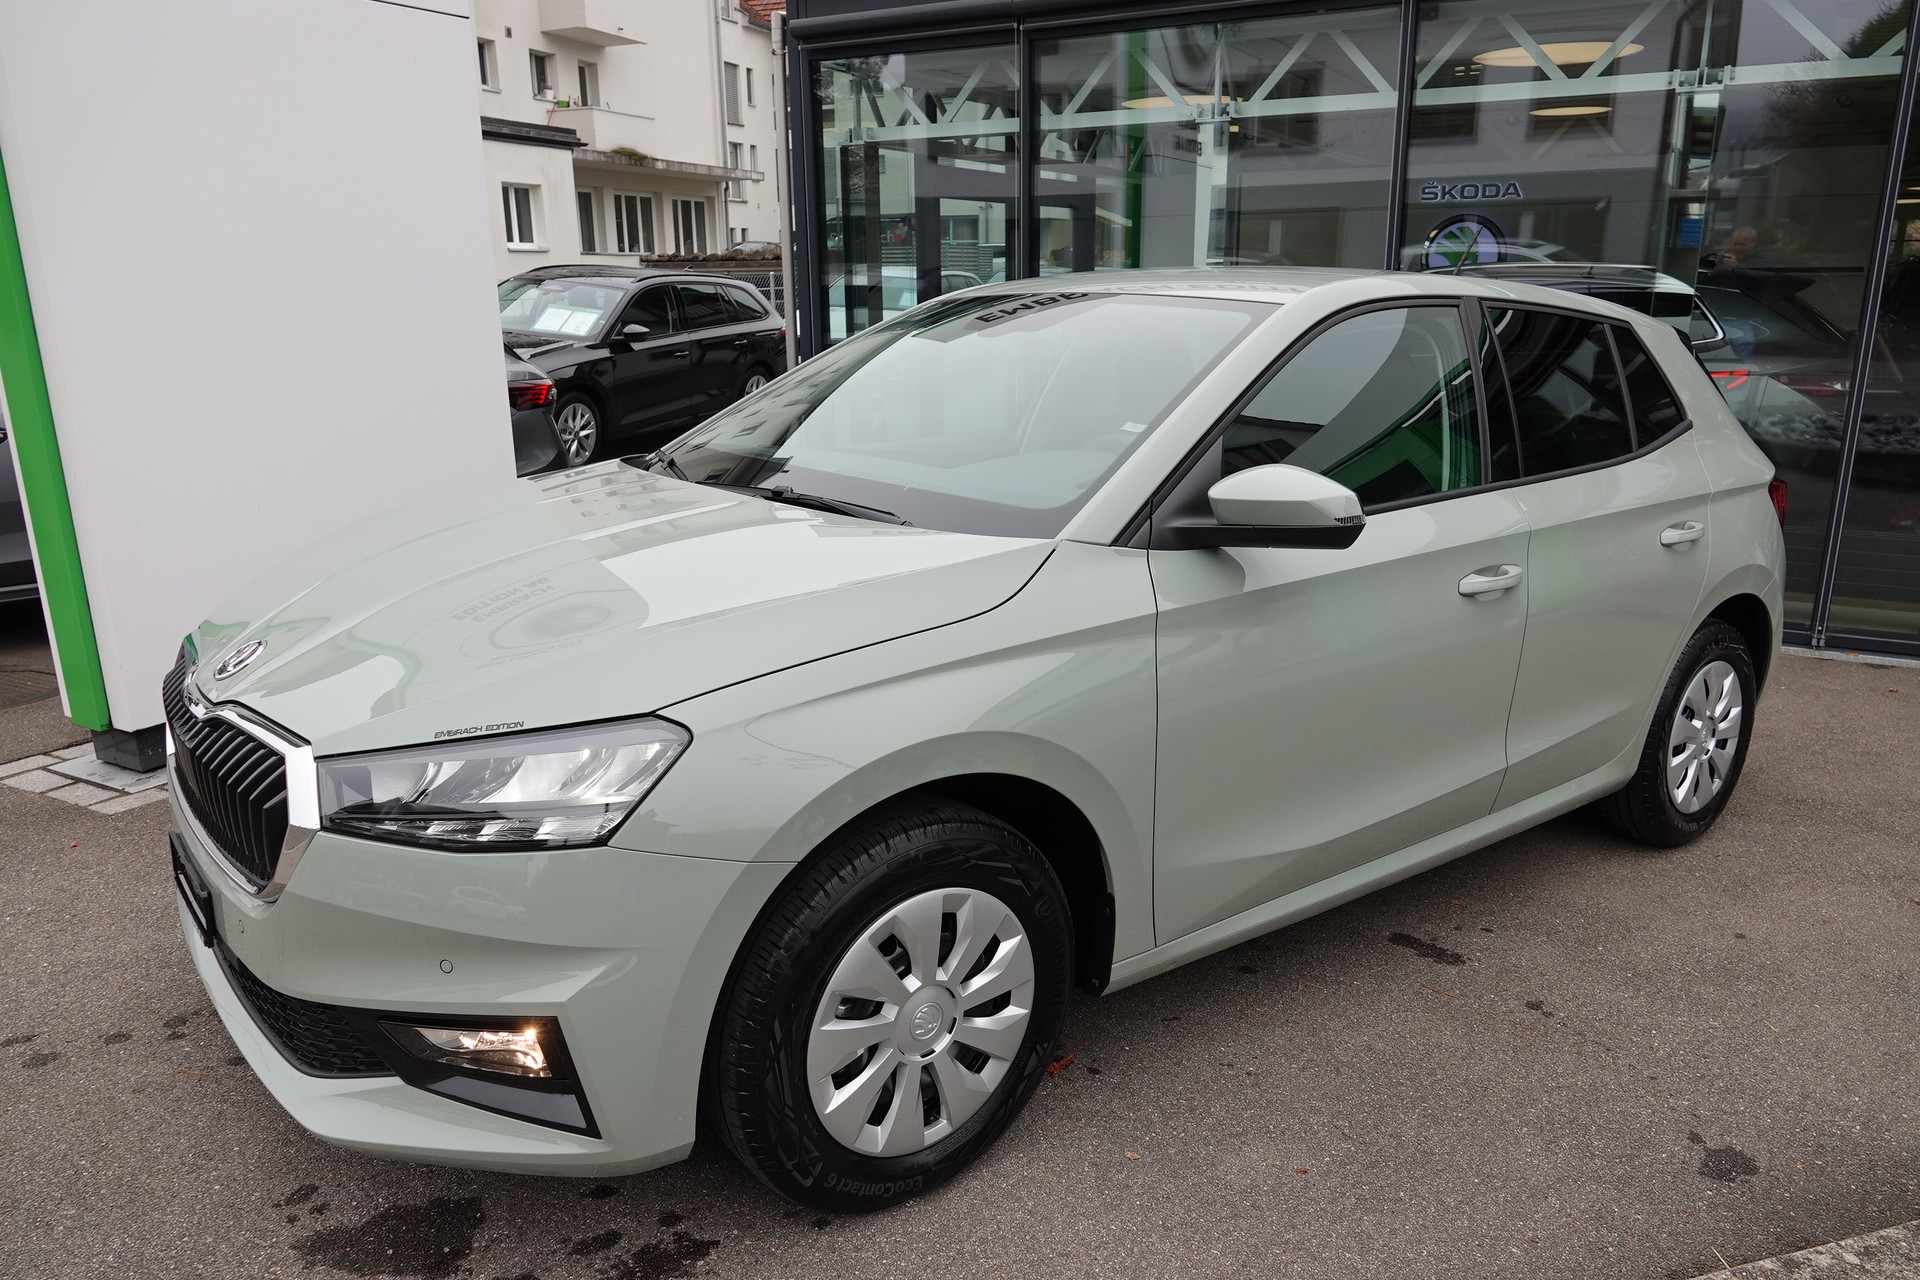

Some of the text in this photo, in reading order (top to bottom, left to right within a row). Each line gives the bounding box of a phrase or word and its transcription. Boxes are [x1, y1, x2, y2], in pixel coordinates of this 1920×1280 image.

[1421, 181, 1522, 201] ŠKODA
[485, 721, 525, 732] EDITION
[823, 1172, 923, 1198] EcoContact 6
